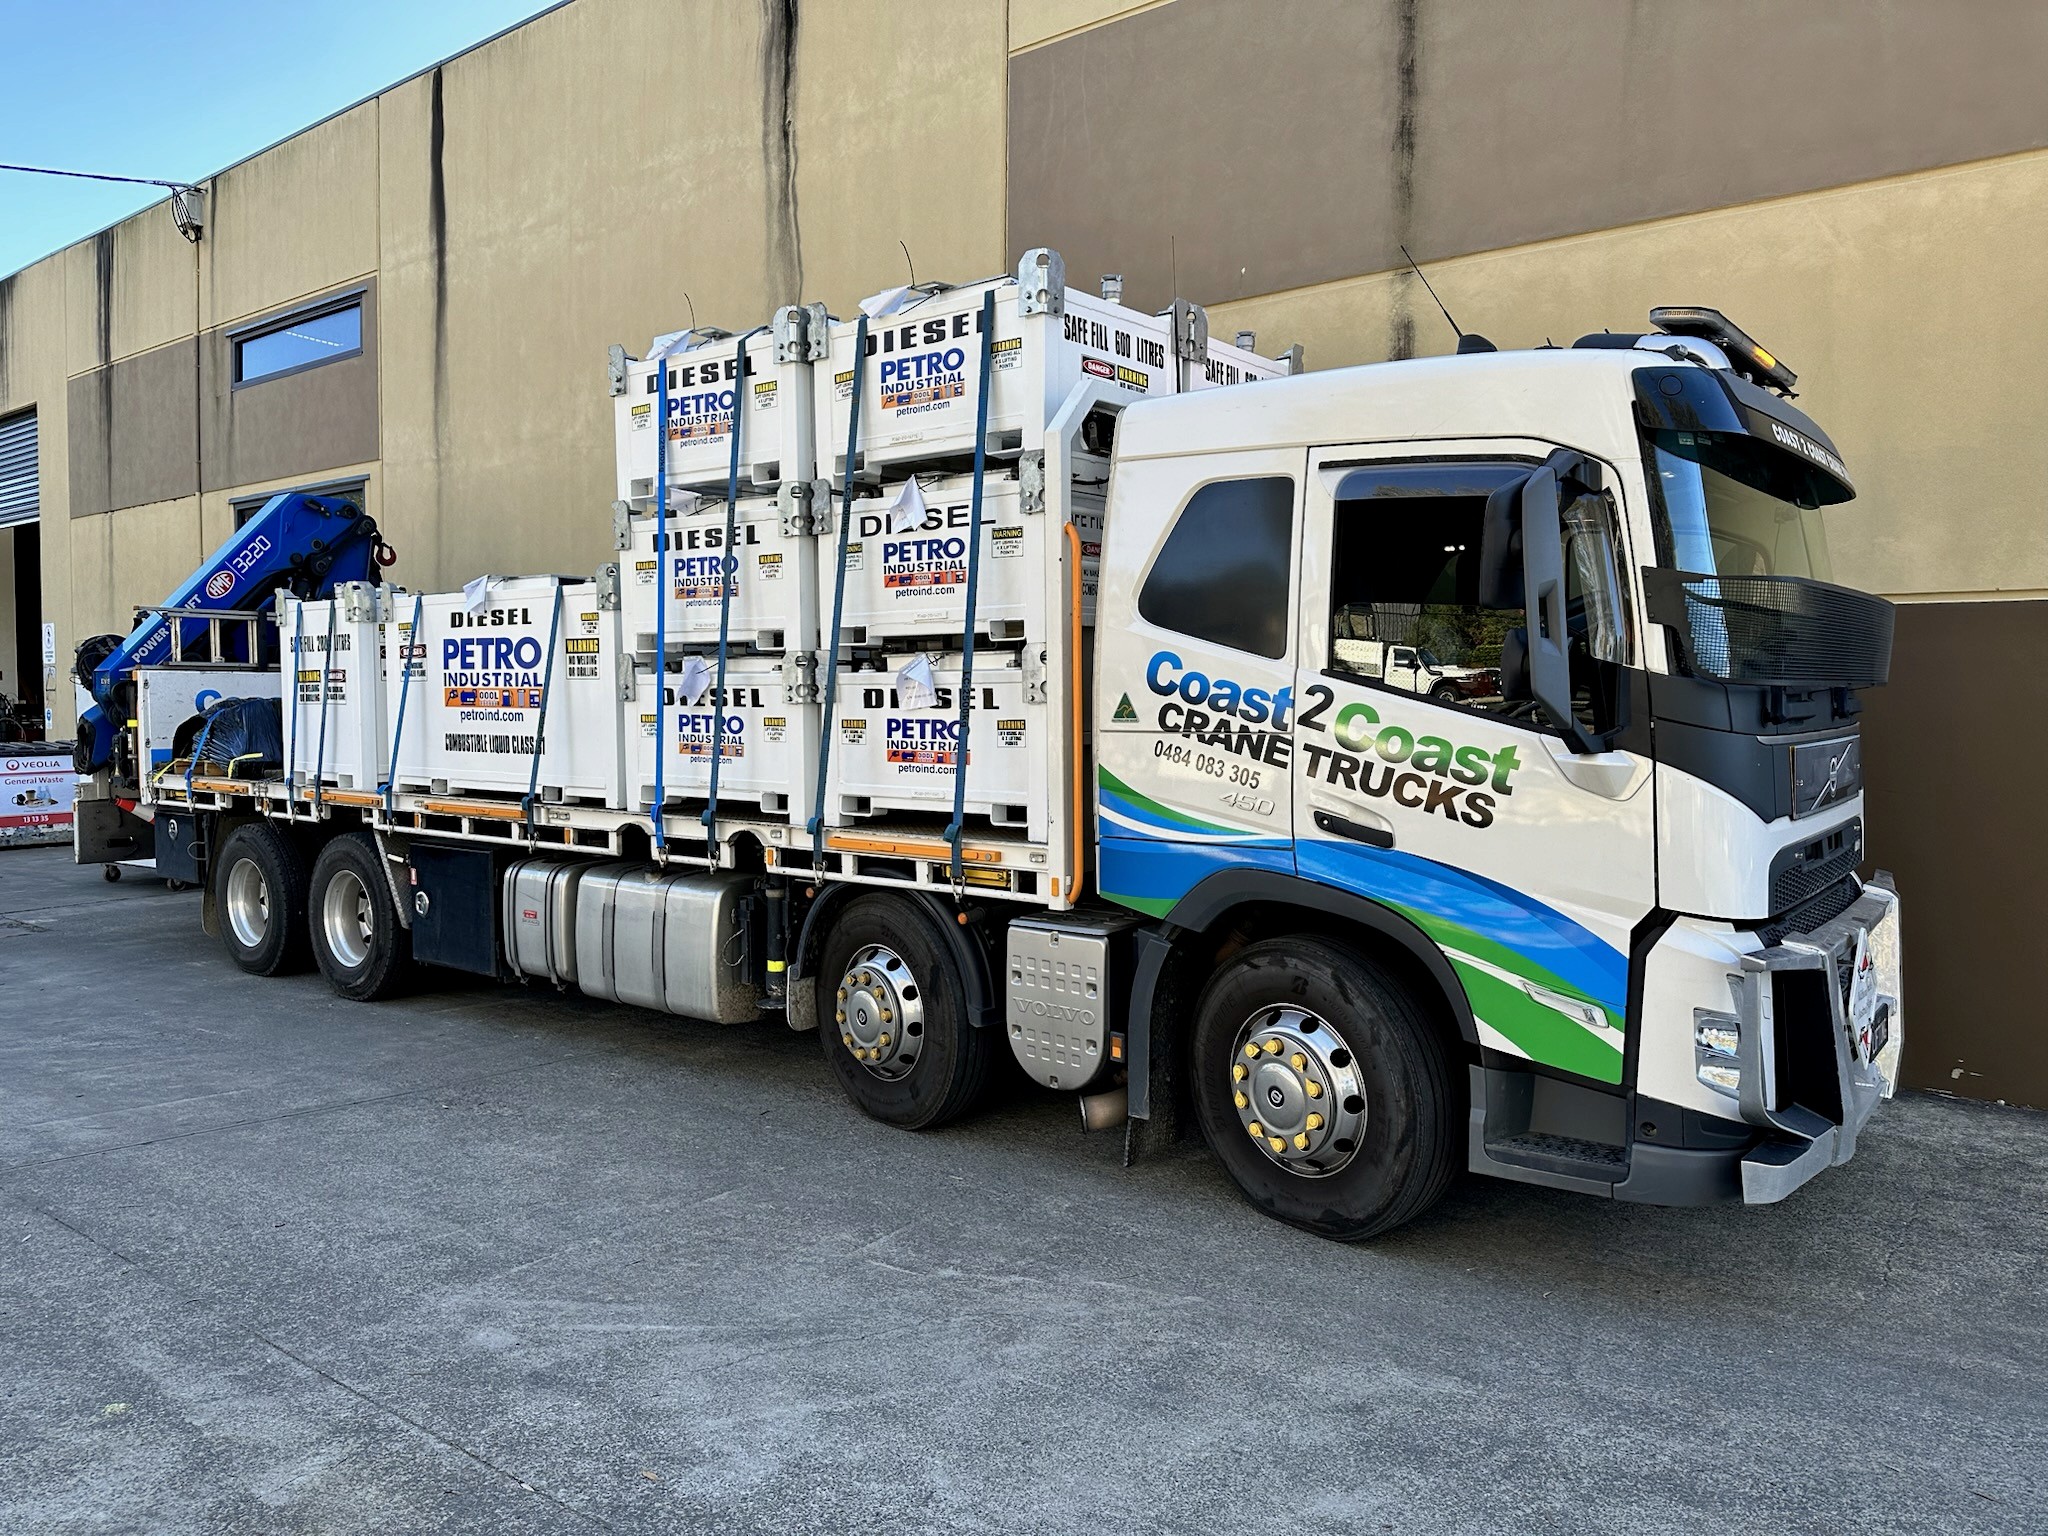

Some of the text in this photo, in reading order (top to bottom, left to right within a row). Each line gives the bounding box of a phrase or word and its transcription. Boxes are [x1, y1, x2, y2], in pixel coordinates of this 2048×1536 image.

[1064, 313, 1164, 369] SAFE FILL 600 LITRES
[881, 348, 965, 383] PETRO
[1087, 362, 1110, 375] DANGER
[1118, 366, 1147, 387] WARNING
[1205, 358, 1224, 385] SAFE
[881, 372, 965, 395] INDUSTRIAL
[667, 390, 735, 418] PETRO
[896, 401, 950, 418] petroind.com
[680, 436, 724, 449] petroind.com
[1772, 423, 1801, 451] COAST
[1800, 437, 1809, 455] 2
[993, 529, 1022, 538] WARNING
[232, 535, 272, 573] 3220
[883, 537, 965, 563] PETRO
[883, 560, 966, 575] INDUSTRIAL
[207, 574, 233, 596] HMF
[896, 586, 955, 599] petroind.com
[686, 599, 722, 608] petroind.co
[450, 608, 532, 629] DIESEL
[131, 627, 170, 663] POWER
[443, 637, 542, 670] PETRO
[567, 639, 598, 652] WARNING
[444, 672, 543, 687] INDUSTRIAL
[461, 708, 524, 723] petroind.com
[1146, 651, 1521, 796] Coast 2 Coast
[445, 733, 487, 753] COMBUSTIBLE
[489, 734, 510, 754] LIQUID
[512, 735, 535, 755] CLASS
[679, 733, 744, 745] INDUSRIAL
[1155, 740, 1261, 789] 0484 083 305
[1158, 703, 1496, 830] CRANE TRUCKS
[5, 777, 37, 785] General
[1218, 792, 1275, 817] 450
[1013, 996, 1096, 1026] VOLVO
